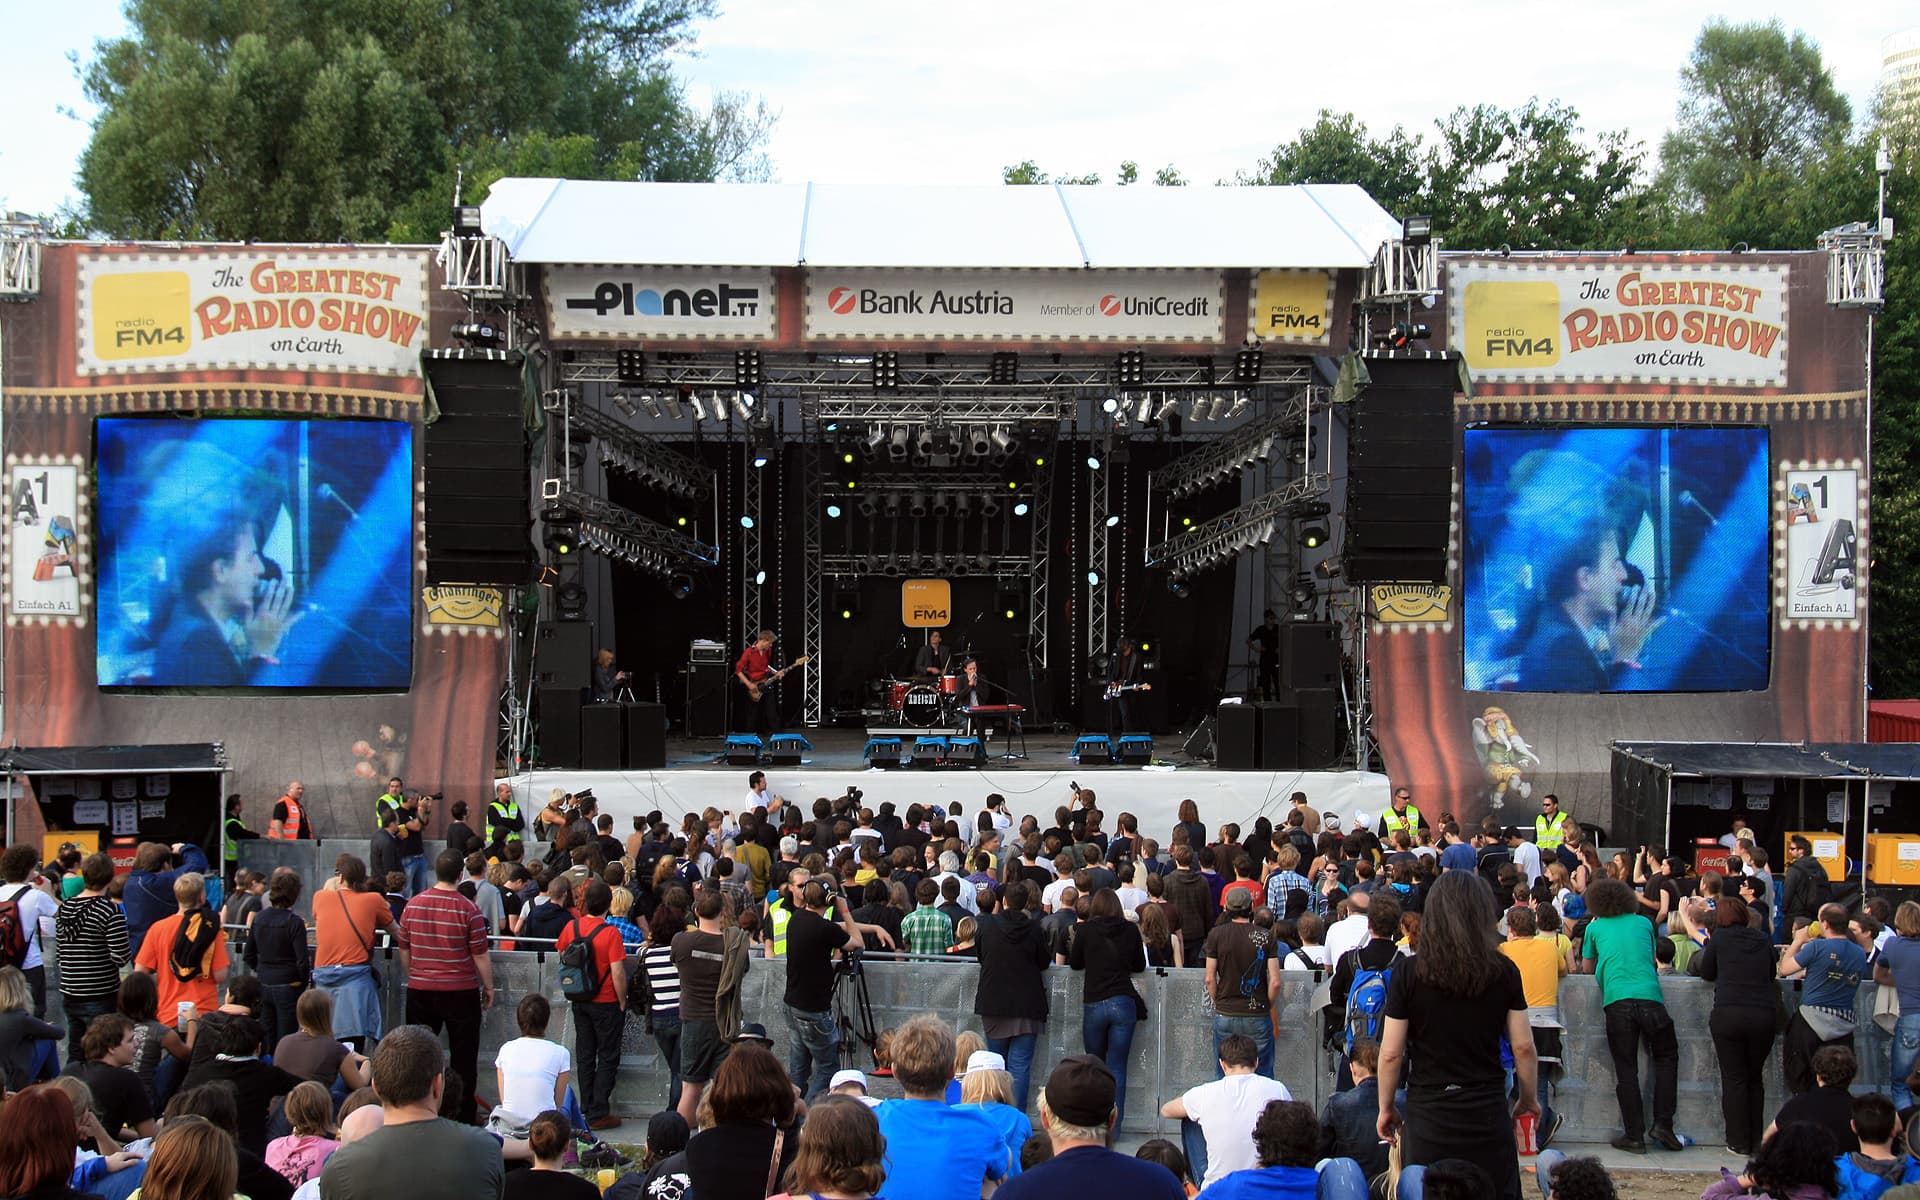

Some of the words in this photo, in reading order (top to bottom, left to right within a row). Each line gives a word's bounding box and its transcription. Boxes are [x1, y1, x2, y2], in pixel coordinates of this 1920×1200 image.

[211, 266, 244, 288] The
[249, 261, 401, 301] GREATEST
[860, 289, 923, 314] Bank
[929, 290, 1014, 315] Austria
[1579, 278, 1610, 300] The
[1616, 272, 1762, 314] GREATEST
[1040, 304, 1083, 316] Member
[1086, 304, 1095, 316] of
[1124, 296, 1209, 317] UniCredit
[115, 317, 155, 328] radio
[194, 295, 316, 340] RADIO
[318, 298, 422, 348] SHOW
[1270, 314, 1321, 328] FM4
[116, 326, 185, 348] FM4
[1486, 328, 1525, 337] radio
[1562, 308, 1679, 353] RADIO
[1681, 310, 1781, 359] SHOW
[270, 338, 293, 351] on
[296, 336, 344, 355] Earth
[1486, 338, 1554, 357] FM4
[1633, 355, 1656, 366] on
[1658, 349, 1705, 368] Earth
[18, 600, 55, 610] Einfach
[1794, 603, 1833, 613] Einfach
[913, 610, 948, 621] FM4
